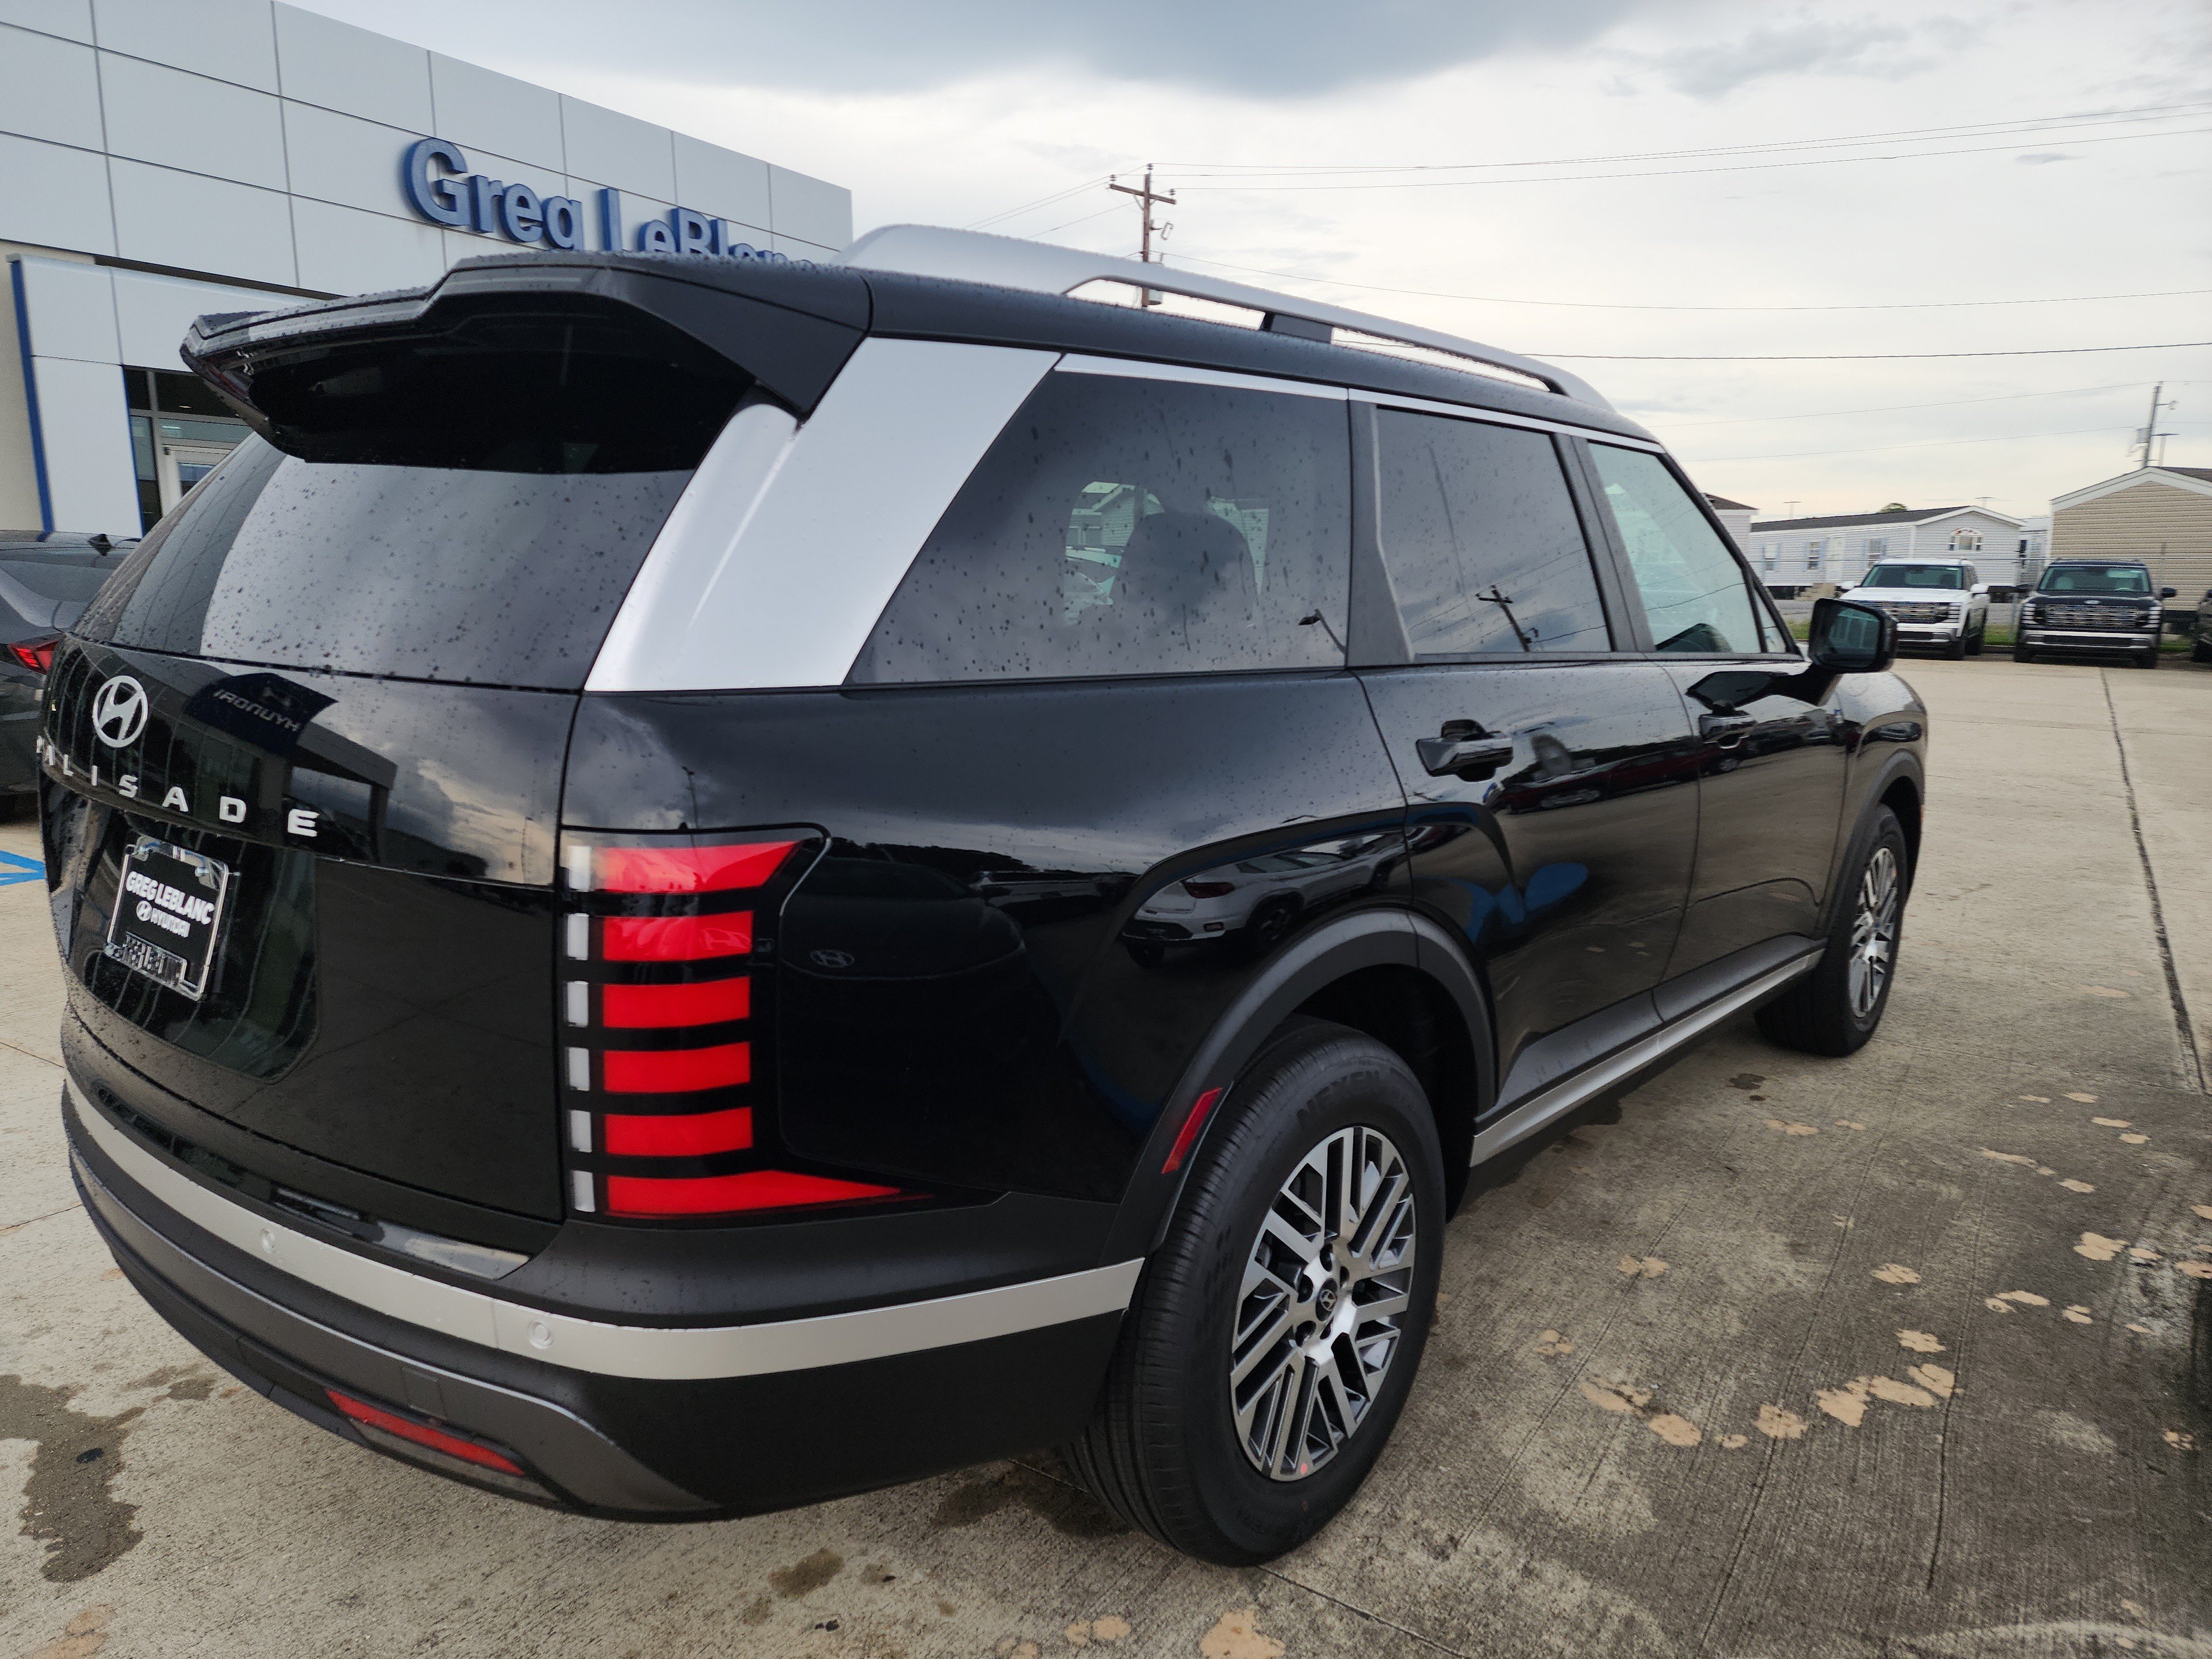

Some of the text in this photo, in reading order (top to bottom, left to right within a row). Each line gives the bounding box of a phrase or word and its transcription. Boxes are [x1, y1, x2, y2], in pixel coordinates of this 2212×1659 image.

[403, 138, 584, 251] Greg
[126, 870, 215, 925] GREG LEBLANC
[150, 907, 191, 938] HYUNDAI
